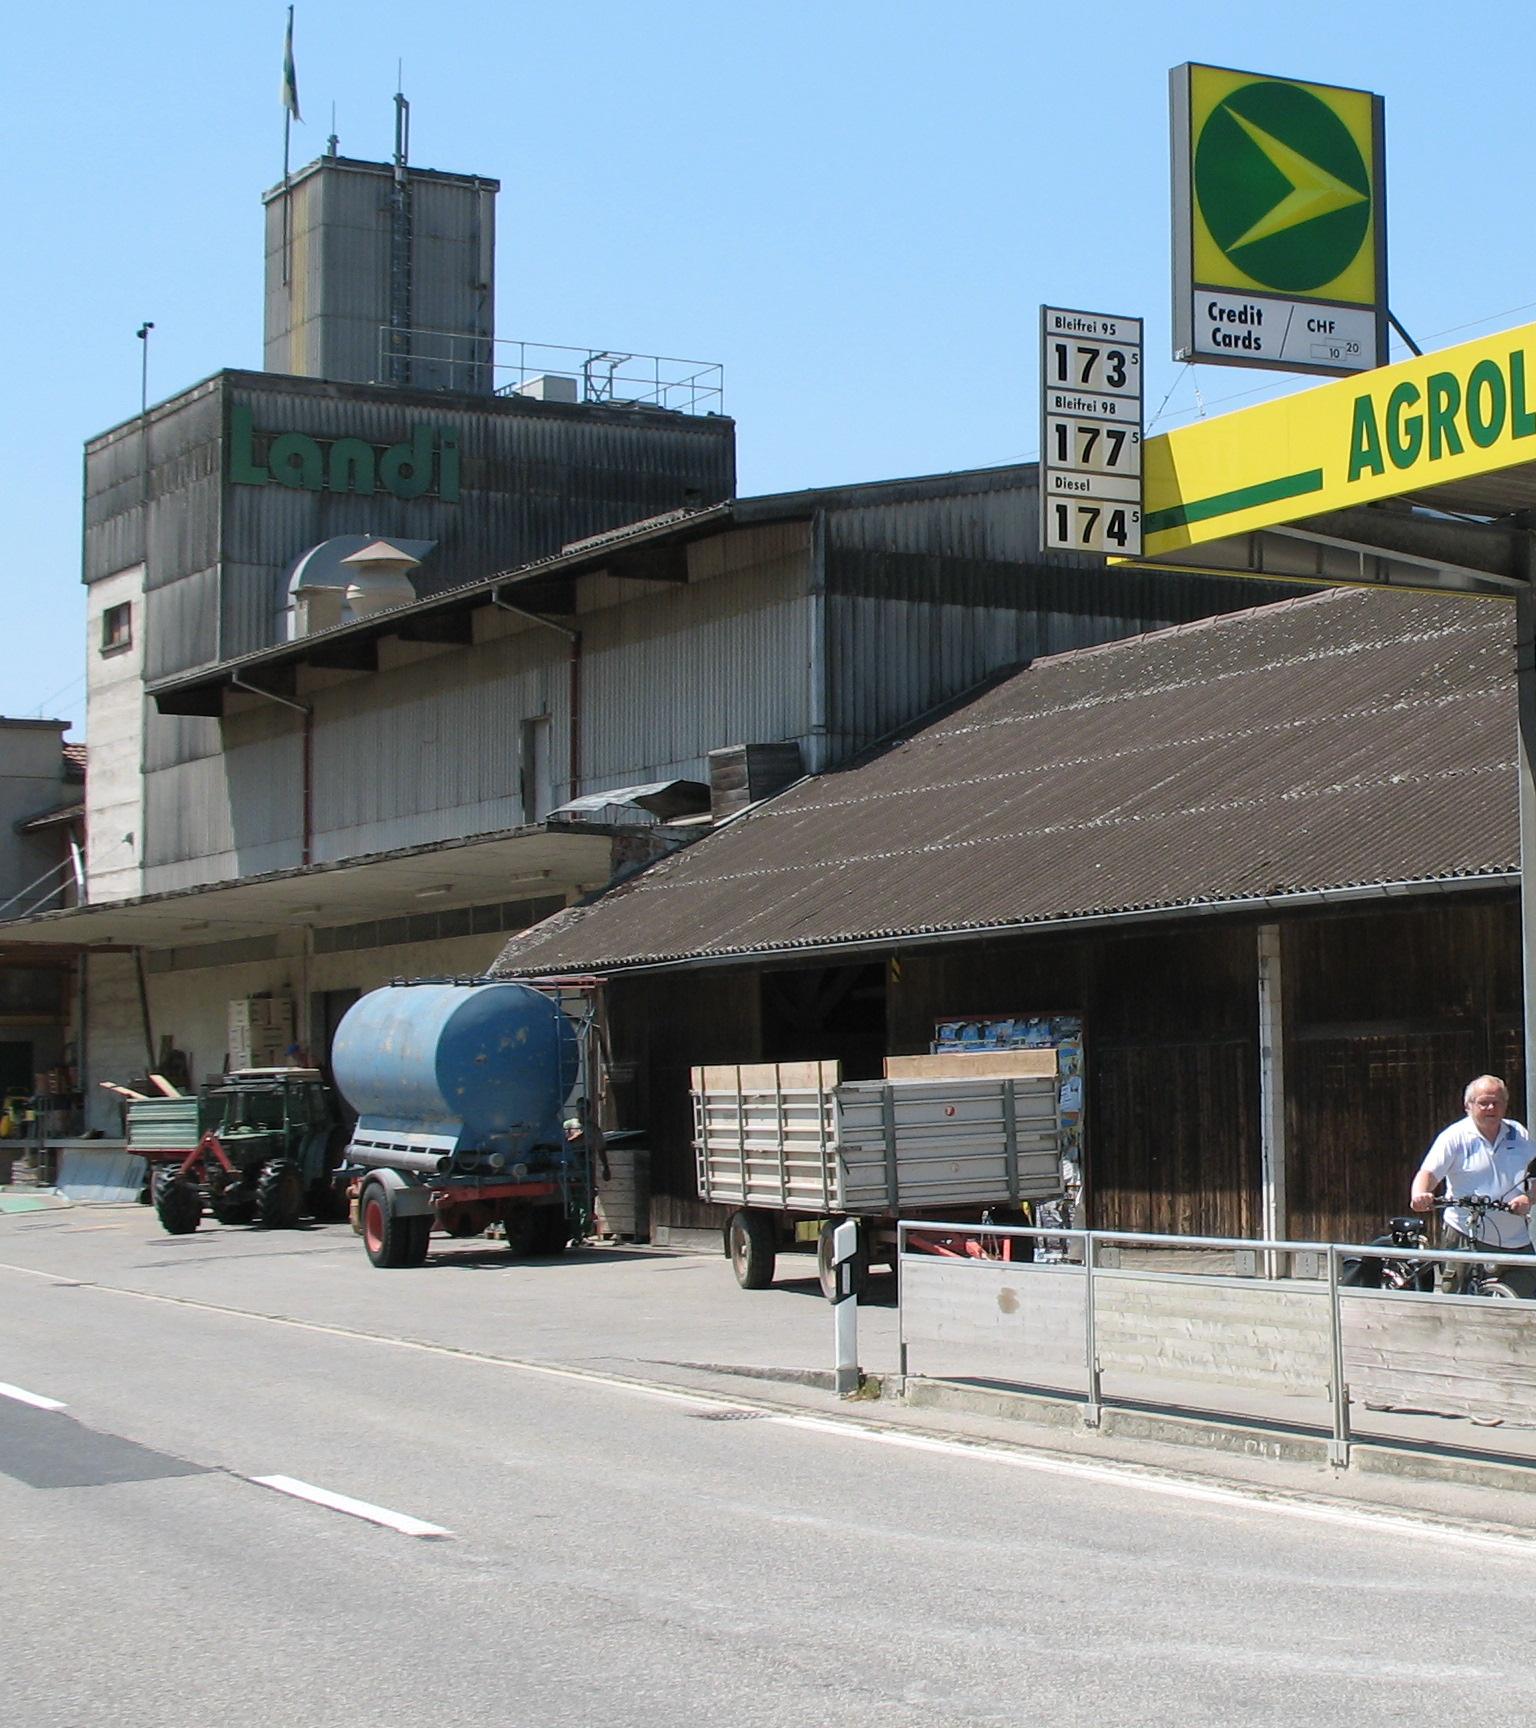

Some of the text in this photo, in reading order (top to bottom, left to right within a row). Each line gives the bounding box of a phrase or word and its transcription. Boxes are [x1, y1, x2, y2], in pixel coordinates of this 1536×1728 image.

[1208, 301, 1263, 326] Credit
[1055, 316, 1116, 336] Bleifrei 95
[1307, 318, 1336, 334] CHF
[1211, 327, 1262, 350] Cards
[1346, 342, 1359, 353] 20
[1329, 348, 1340, 358] 10
[1055, 396, 1116, 414] Bleifrei 98
[230, 404, 460, 503] Landi
[1055, 476, 1090, 491] Diesel
